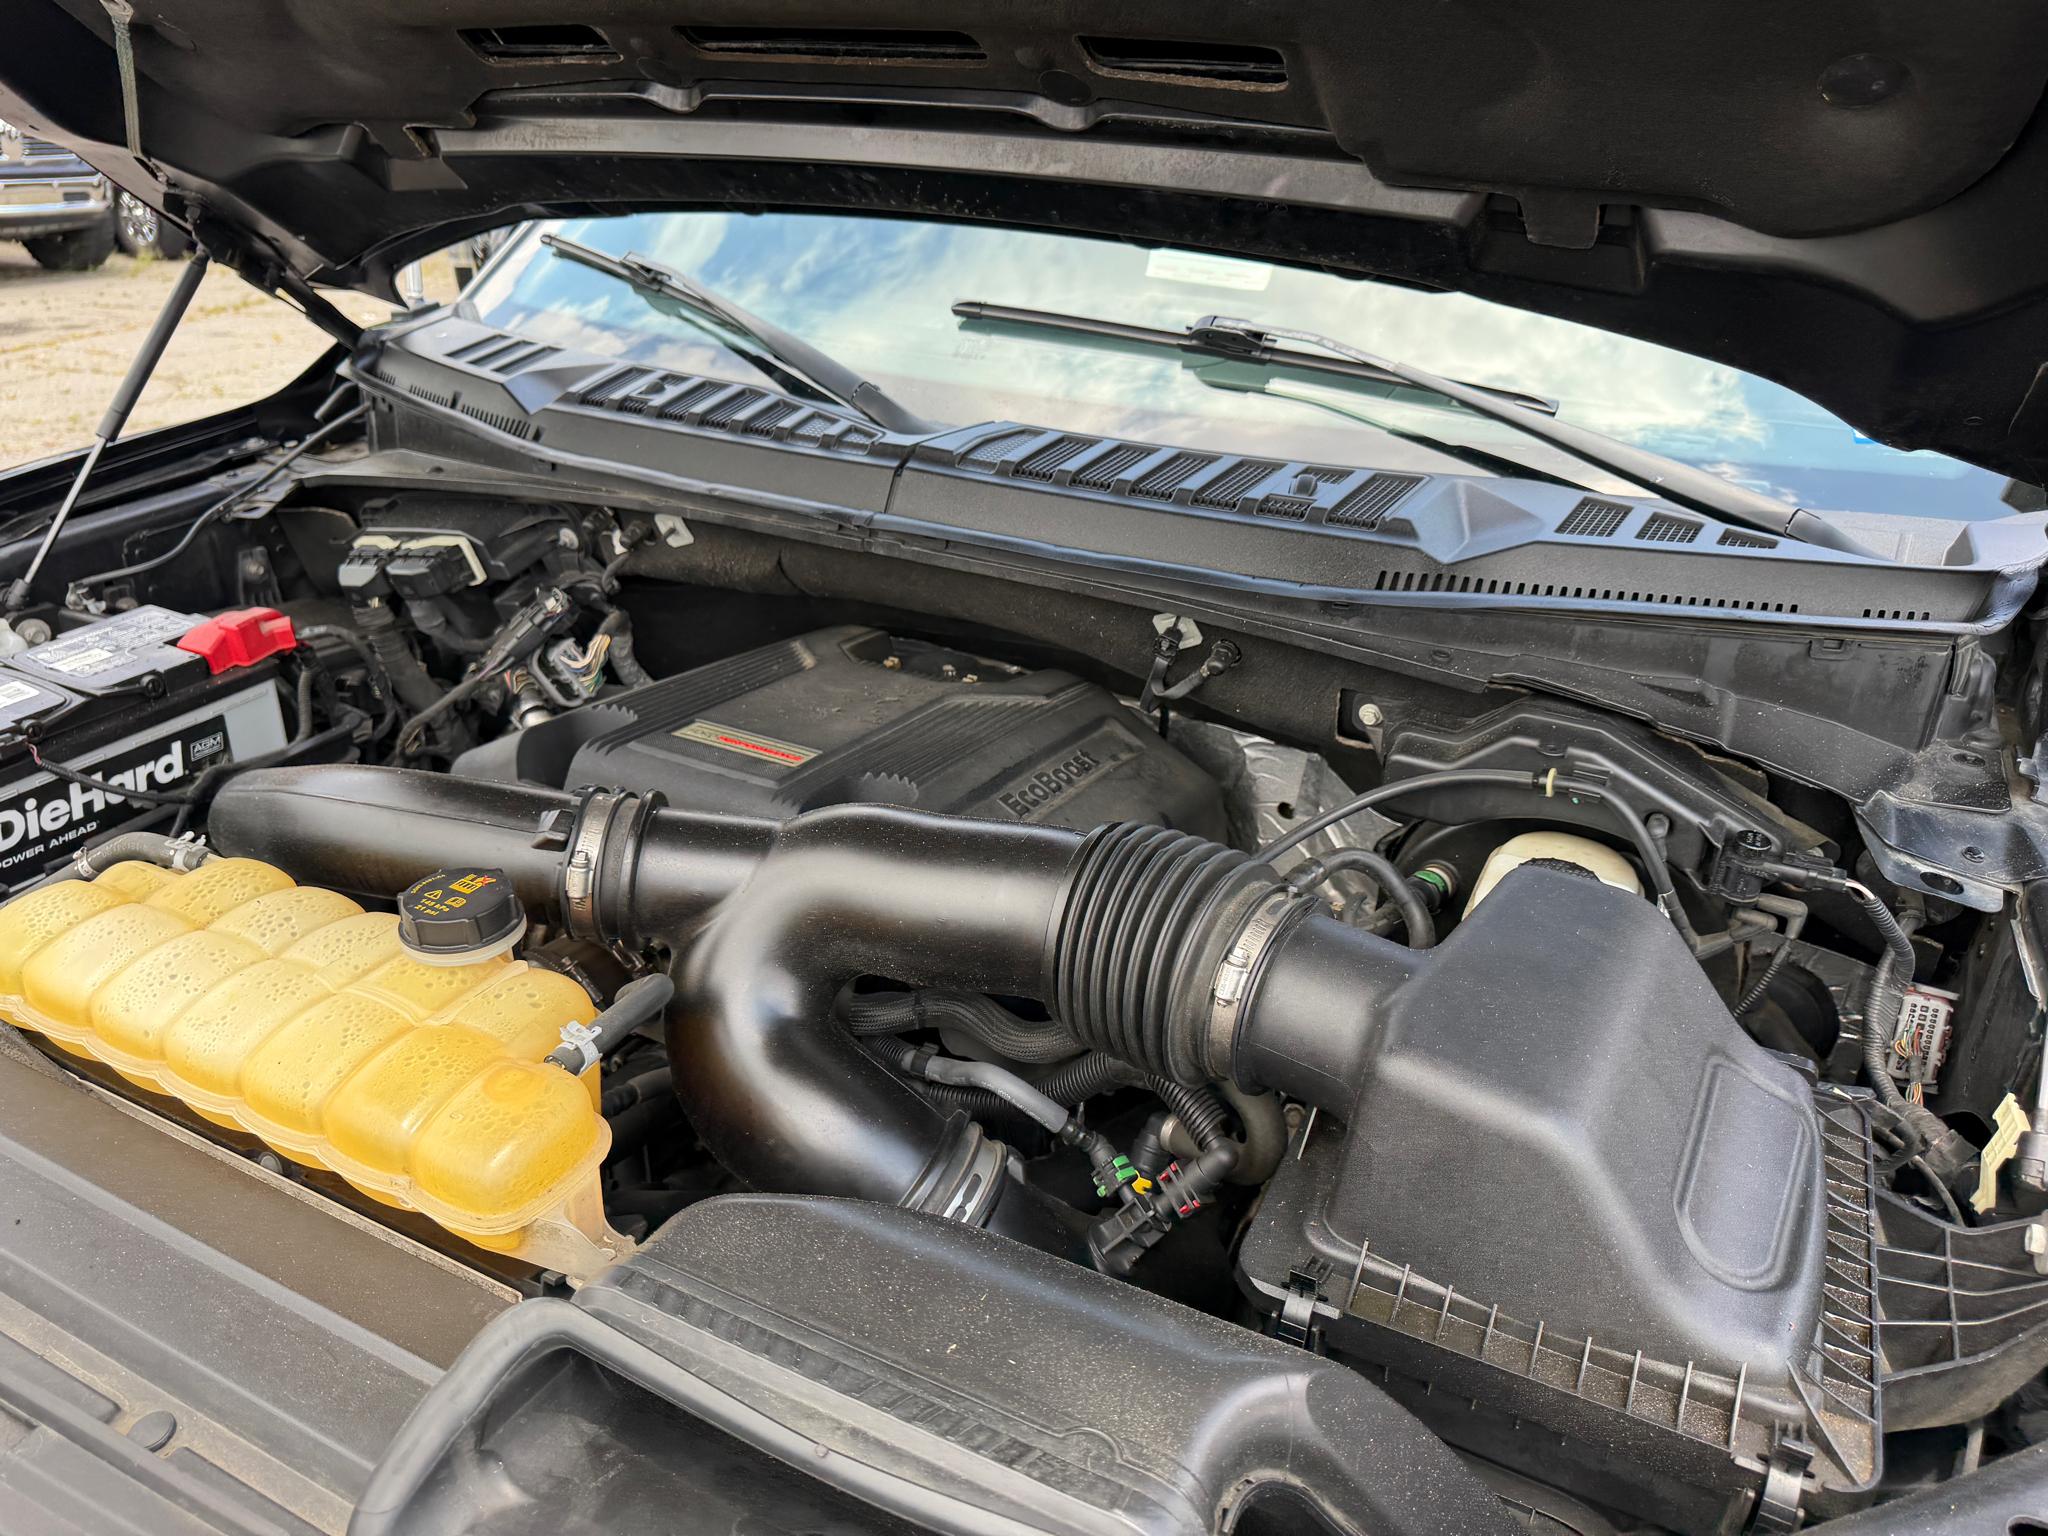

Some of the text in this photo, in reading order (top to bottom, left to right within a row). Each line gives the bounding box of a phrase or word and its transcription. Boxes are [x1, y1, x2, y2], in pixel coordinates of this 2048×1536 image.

[0, 741, 184, 853] DieHard
[0, 844, 45, 868] OWER
[50, 822, 98, 849] AHEAD
